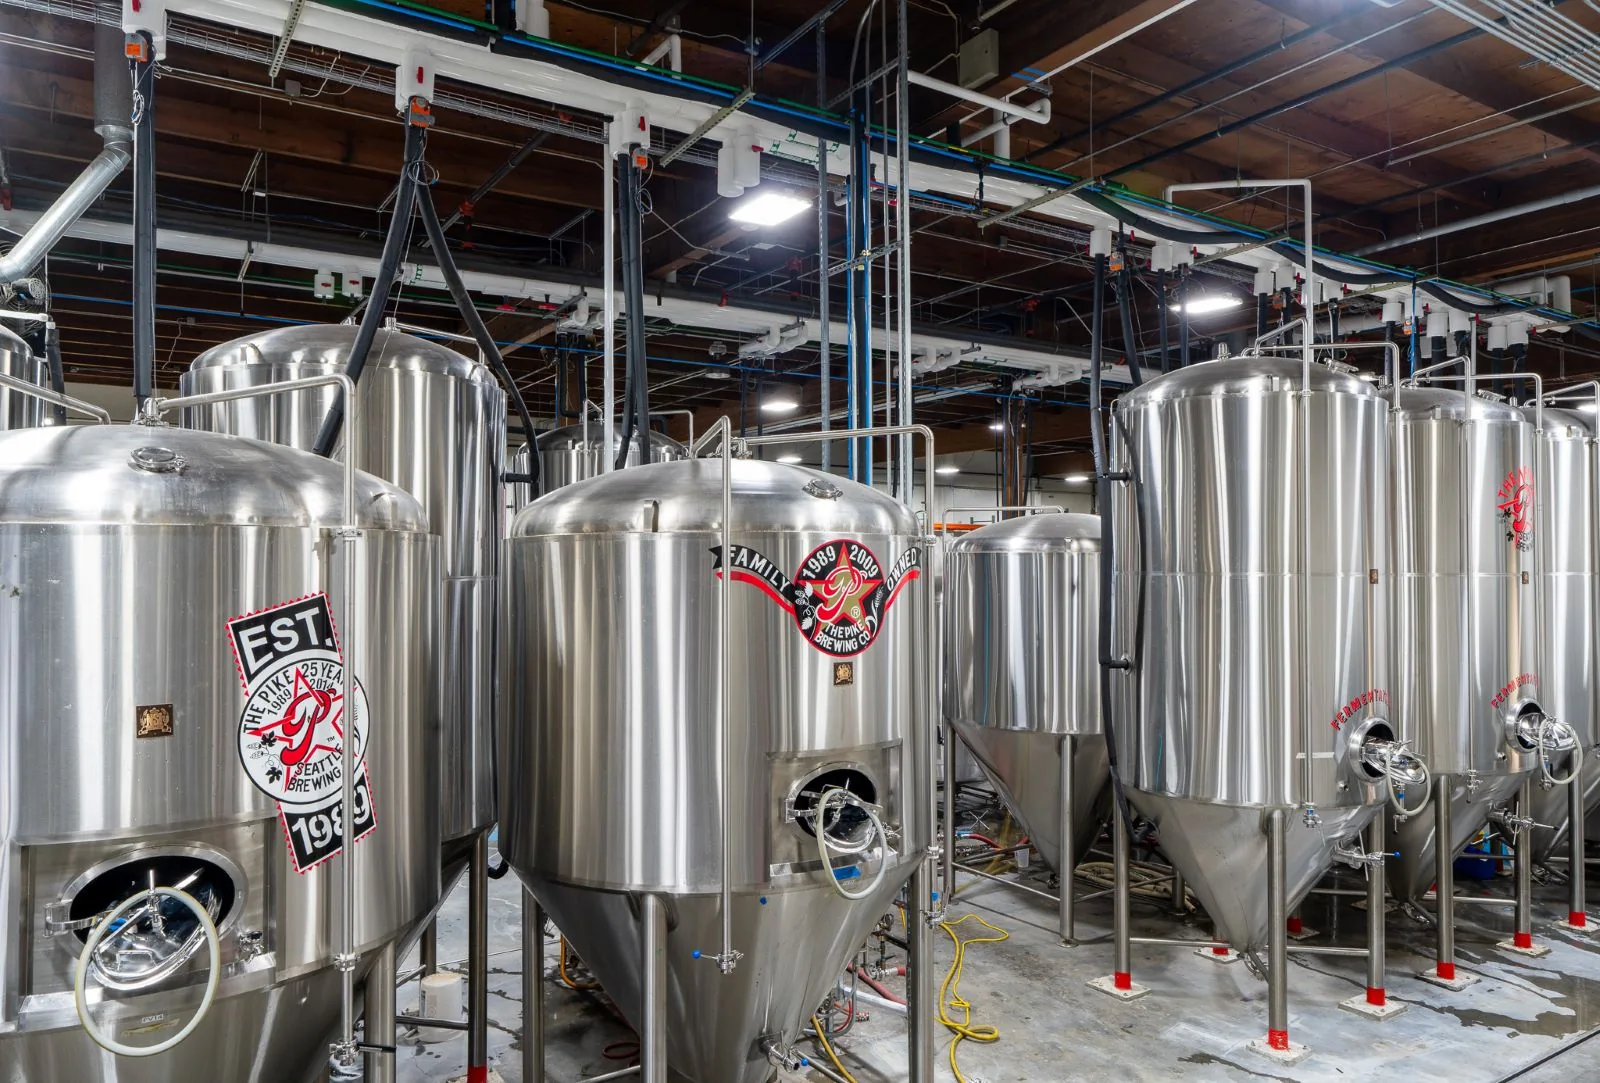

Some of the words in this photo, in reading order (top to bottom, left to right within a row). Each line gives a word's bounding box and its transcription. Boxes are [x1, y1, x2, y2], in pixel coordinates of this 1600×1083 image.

[802, 545, 836, 579] 1989
[849, 544, 878, 578] 2009
[887, 548, 917, 591] OWNED
[238, 607, 334, 676] EST.
[815, 631, 858, 652] BREWING
[825, 621, 844, 638] THE
[844, 620, 865, 638] PIKE
[243, 703, 266, 733] THE
[258, 669, 294, 703] PIKE
[301, 662, 318, 679] 25
[267, 688, 292, 715] 1989
[296, 743, 343, 776] SEATTLE
[287, 766, 342, 792] BREWING
